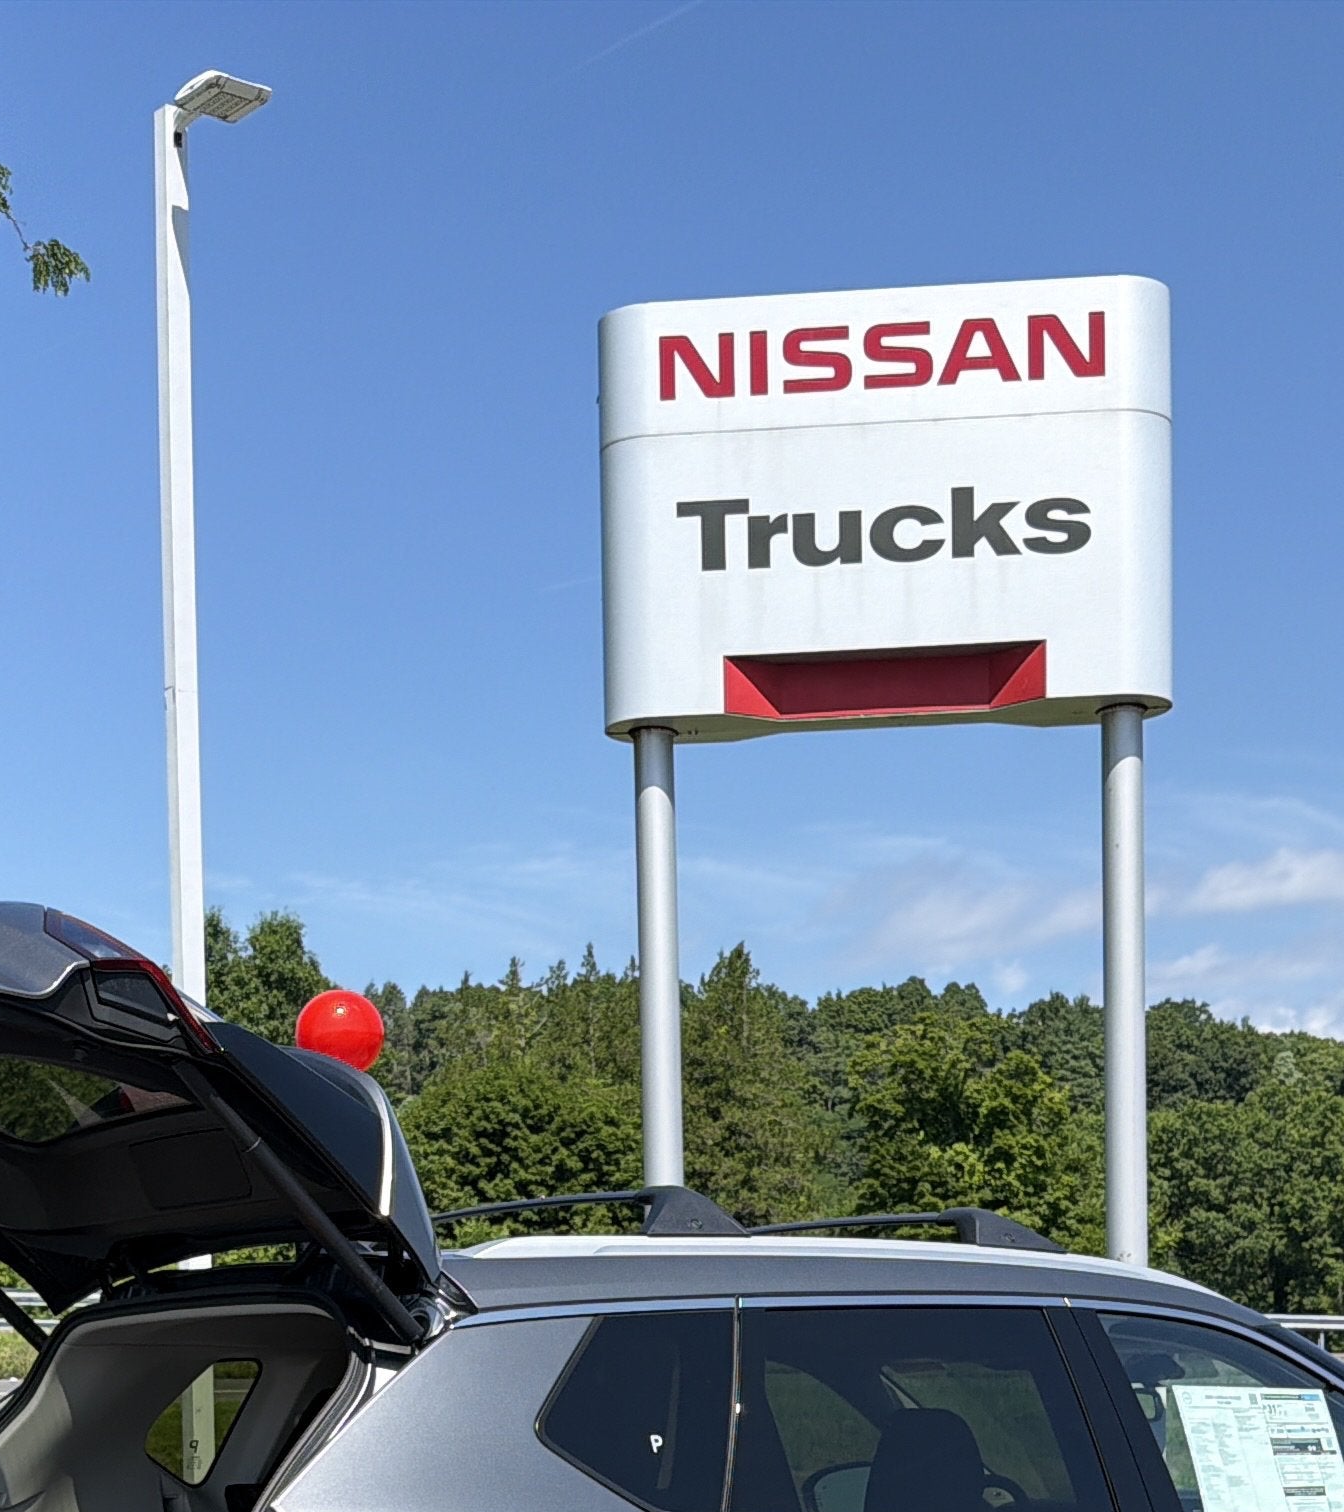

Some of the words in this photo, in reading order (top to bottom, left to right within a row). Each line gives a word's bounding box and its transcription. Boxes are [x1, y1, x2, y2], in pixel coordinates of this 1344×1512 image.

[659, 311, 1106, 400] NISSAN
[676, 486, 1092, 572] Trucks
[650, 1434, 663, 1453] P
